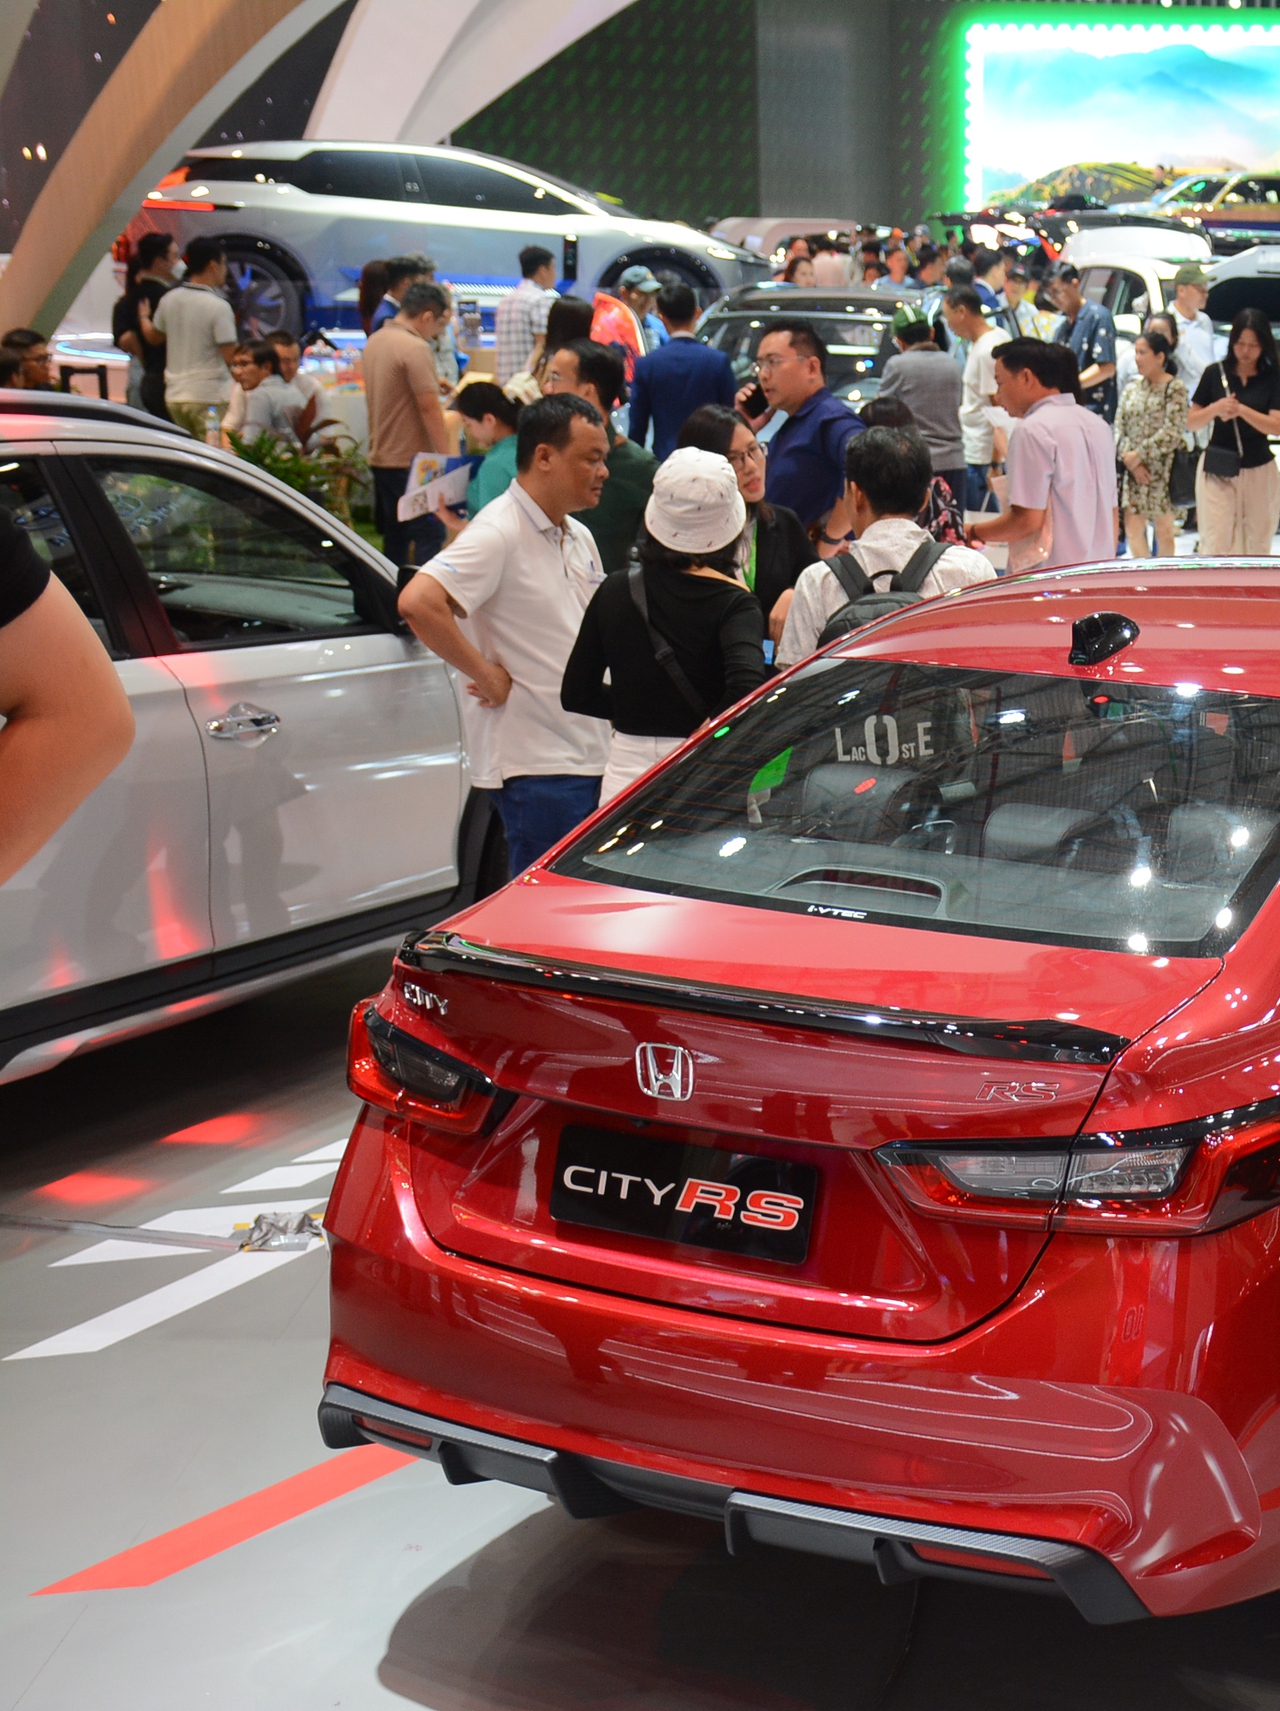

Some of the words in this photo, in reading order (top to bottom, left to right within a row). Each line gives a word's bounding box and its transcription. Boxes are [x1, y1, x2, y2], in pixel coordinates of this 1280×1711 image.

[404, 982, 448, 1015] CITY
[975, 1081, 1060, 1102] RS
[563, 1165, 676, 1206] CITY
[675, 1178, 804, 1231] RS
